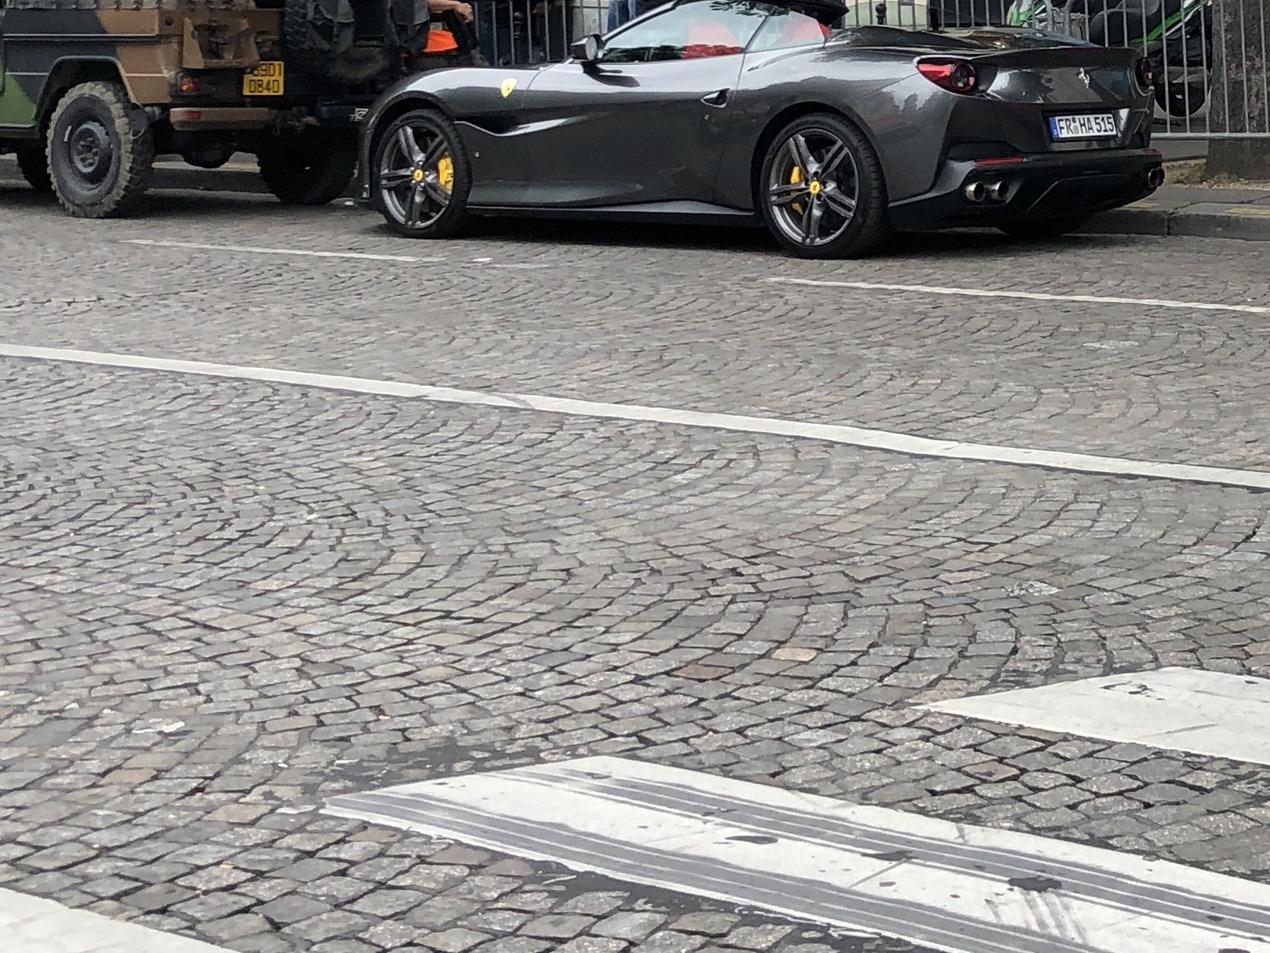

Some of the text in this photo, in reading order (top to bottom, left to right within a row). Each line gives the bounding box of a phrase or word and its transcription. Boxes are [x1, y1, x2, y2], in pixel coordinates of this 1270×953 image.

[1057, 116, 1115, 135] FR HA 515
